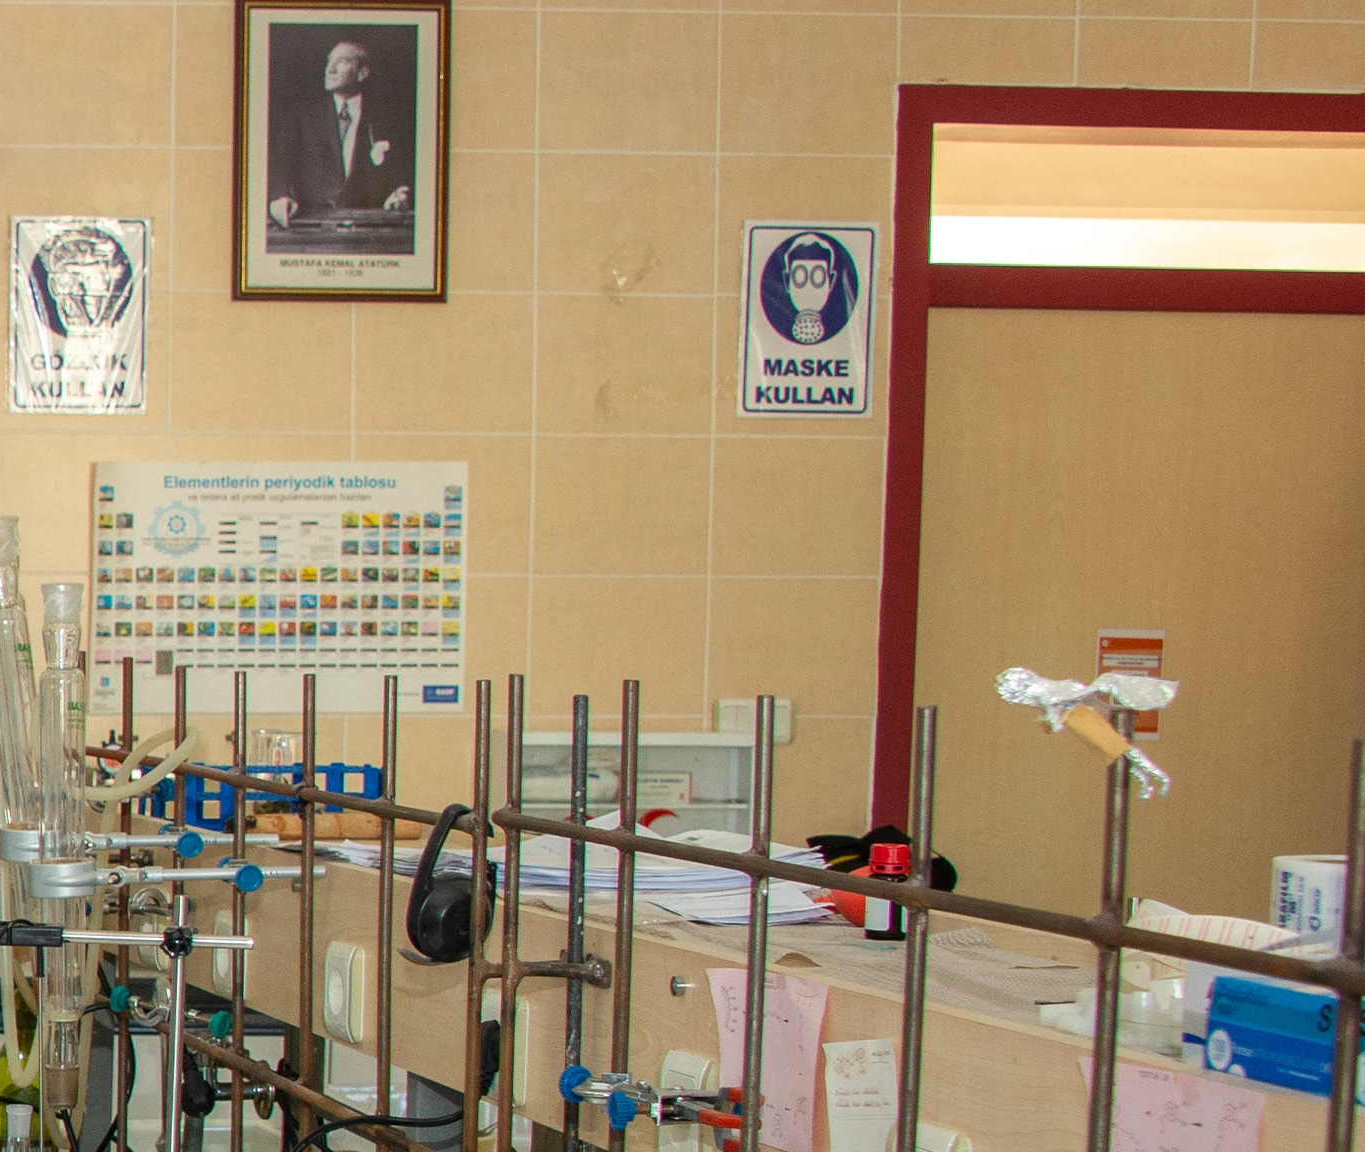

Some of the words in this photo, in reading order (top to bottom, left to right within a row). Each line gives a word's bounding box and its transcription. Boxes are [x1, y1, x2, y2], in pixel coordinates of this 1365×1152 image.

[763, 358, 850, 377] MASKE
[755, 386, 855, 405] KULLAN
[163, 475, 260, 489] Elementlerin
[264, 475, 335, 492] periyodik
[339, 475, 397, 489] tablosu
